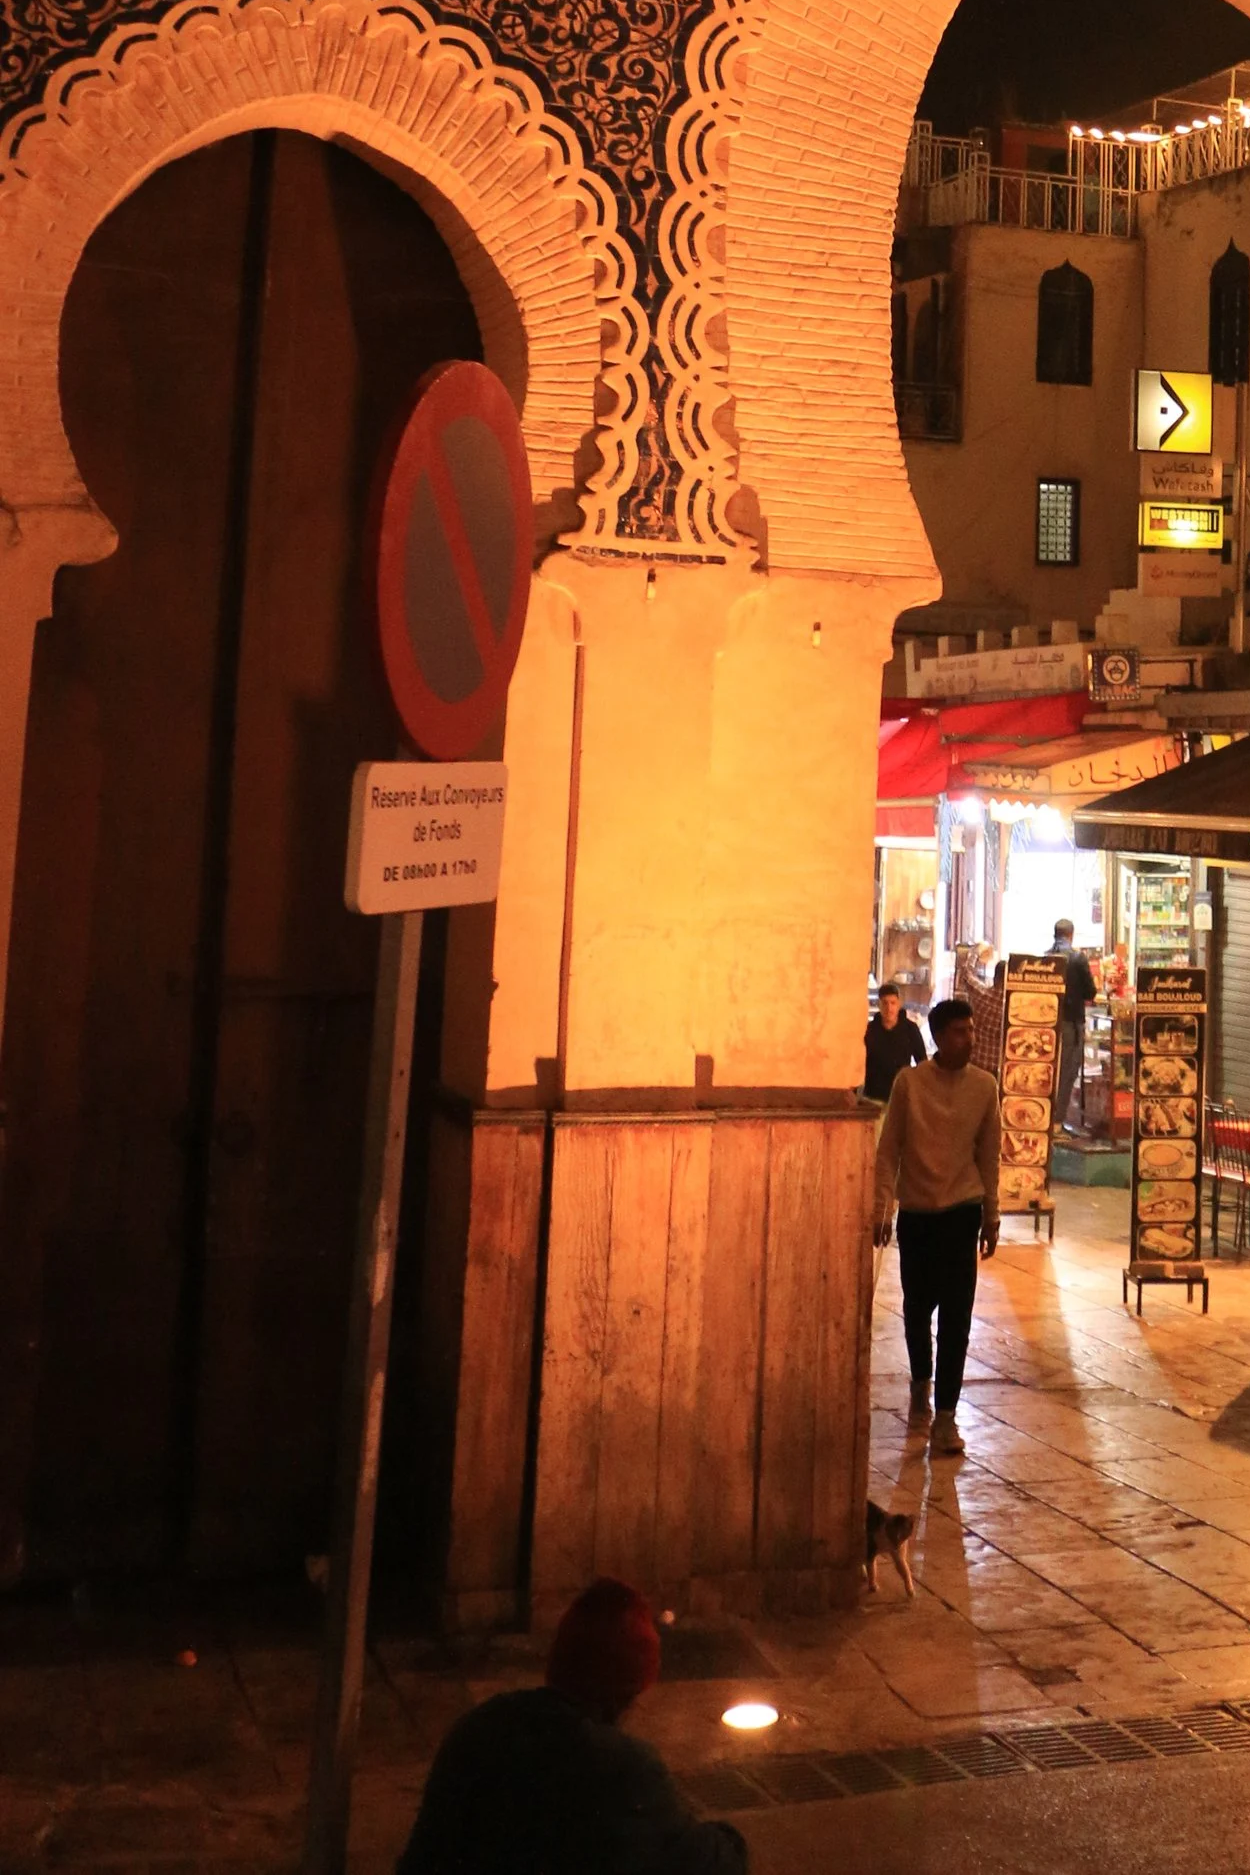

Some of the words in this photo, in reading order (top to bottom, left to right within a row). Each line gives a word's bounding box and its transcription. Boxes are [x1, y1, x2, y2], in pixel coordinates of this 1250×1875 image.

[1151, 508, 1208, 521] WESTERN
[420, 785, 441, 806] Aux
[443, 783, 504, 810] Convoyeurs
[413, 821, 427, 842] de
[429, 819, 462, 842] Fonds
[383, 866, 400, 882] DE
[440, 862, 448, 876] A
[1156, 992, 1203, 1002] BOUJLOUD
